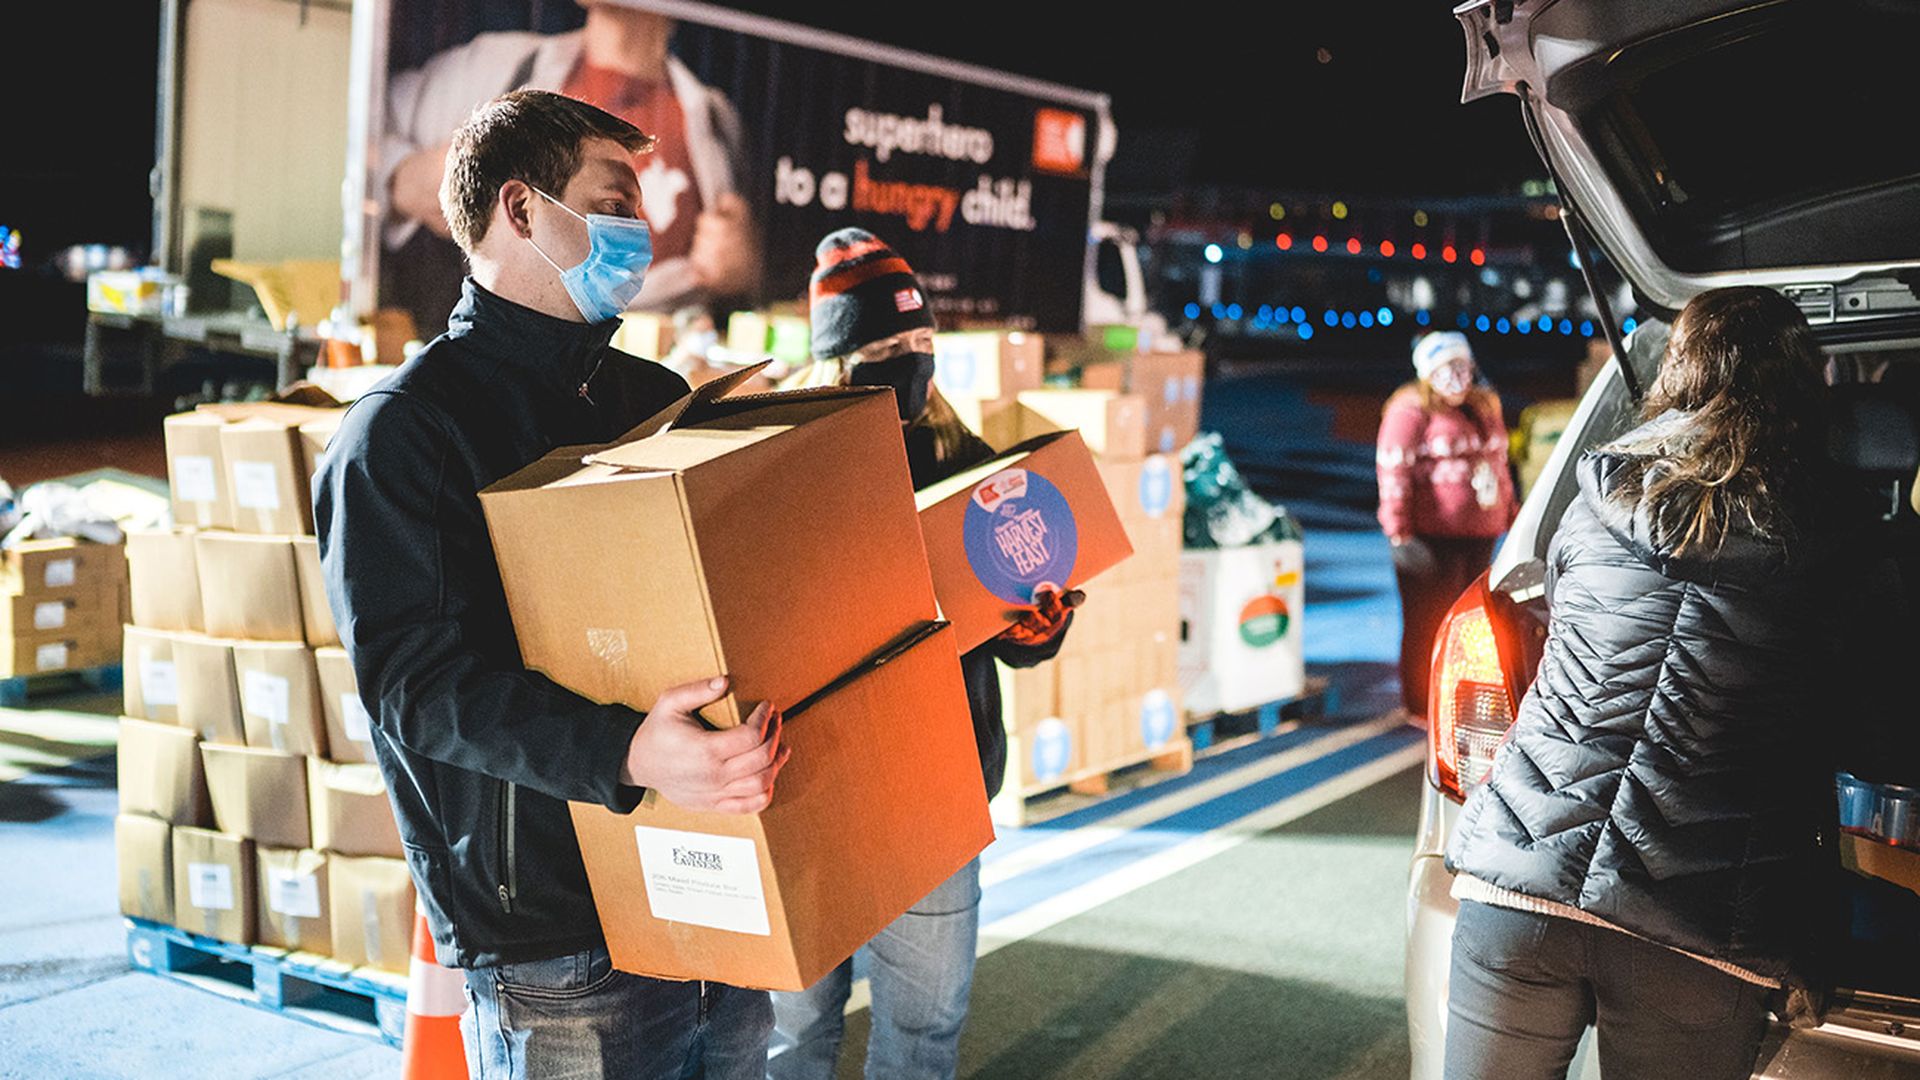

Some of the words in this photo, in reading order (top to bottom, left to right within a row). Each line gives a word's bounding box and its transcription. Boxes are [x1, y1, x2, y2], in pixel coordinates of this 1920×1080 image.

[844, 103, 993, 164] superhero
[775, 155, 815, 207] to
[819, 171, 848, 210] a
[853, 158, 960, 232] hungry
[961, 174, 1037, 231] child.
[994, 508, 1048, 559] HARVEST
[1012, 539, 1051, 576] FEAST
[673, 856, 723, 870] CAVINESS
